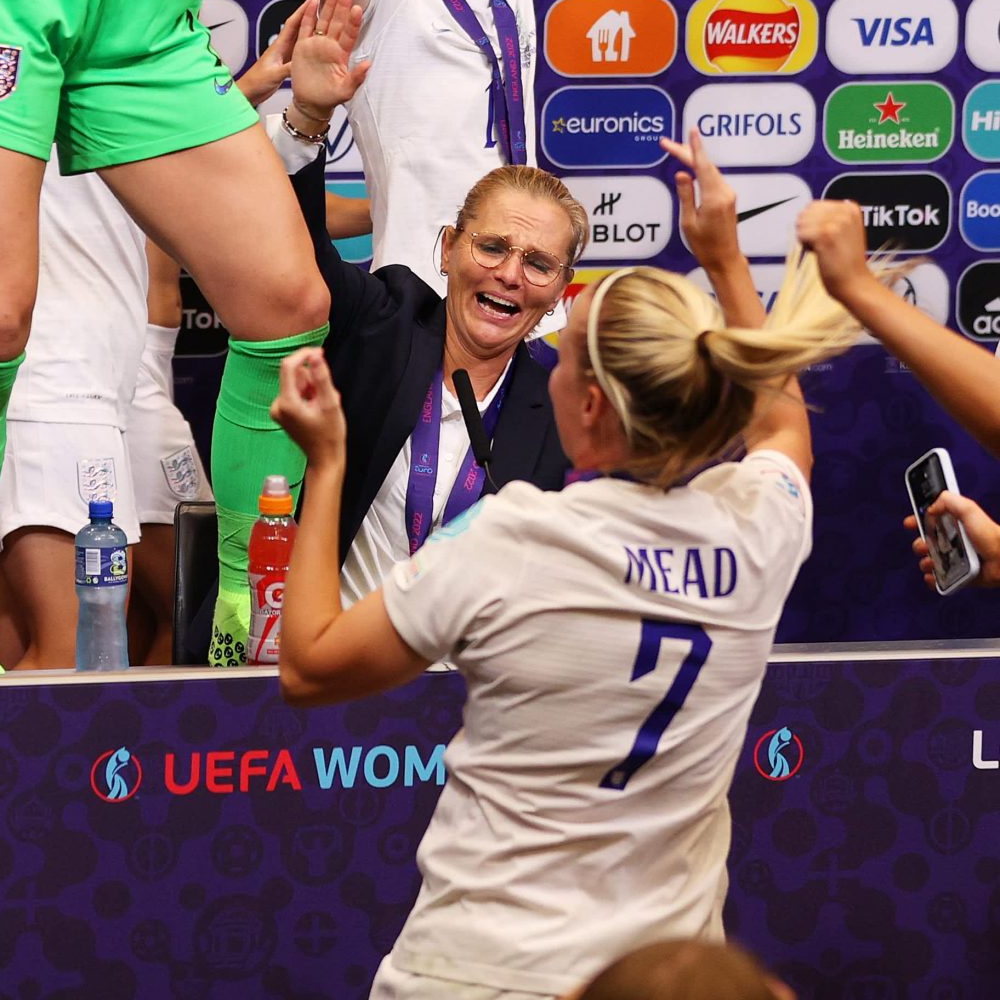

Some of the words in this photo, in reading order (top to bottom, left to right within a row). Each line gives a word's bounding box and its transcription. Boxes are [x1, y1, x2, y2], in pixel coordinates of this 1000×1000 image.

[707, 19, 797, 46] WALKERS
[850, 17, 935, 47] VISA
[566, 112, 664, 134] euronics
[697, 112, 802, 137] GRIFOLS
[837, 128, 939, 150] Heineken
[860, 204, 940, 227] TikTok
[593, 223, 661, 243] BLOT
[623, 545, 738, 600] MEAD
[599, 619, 713, 791] 7
[164, 749, 302, 795] UEFA
